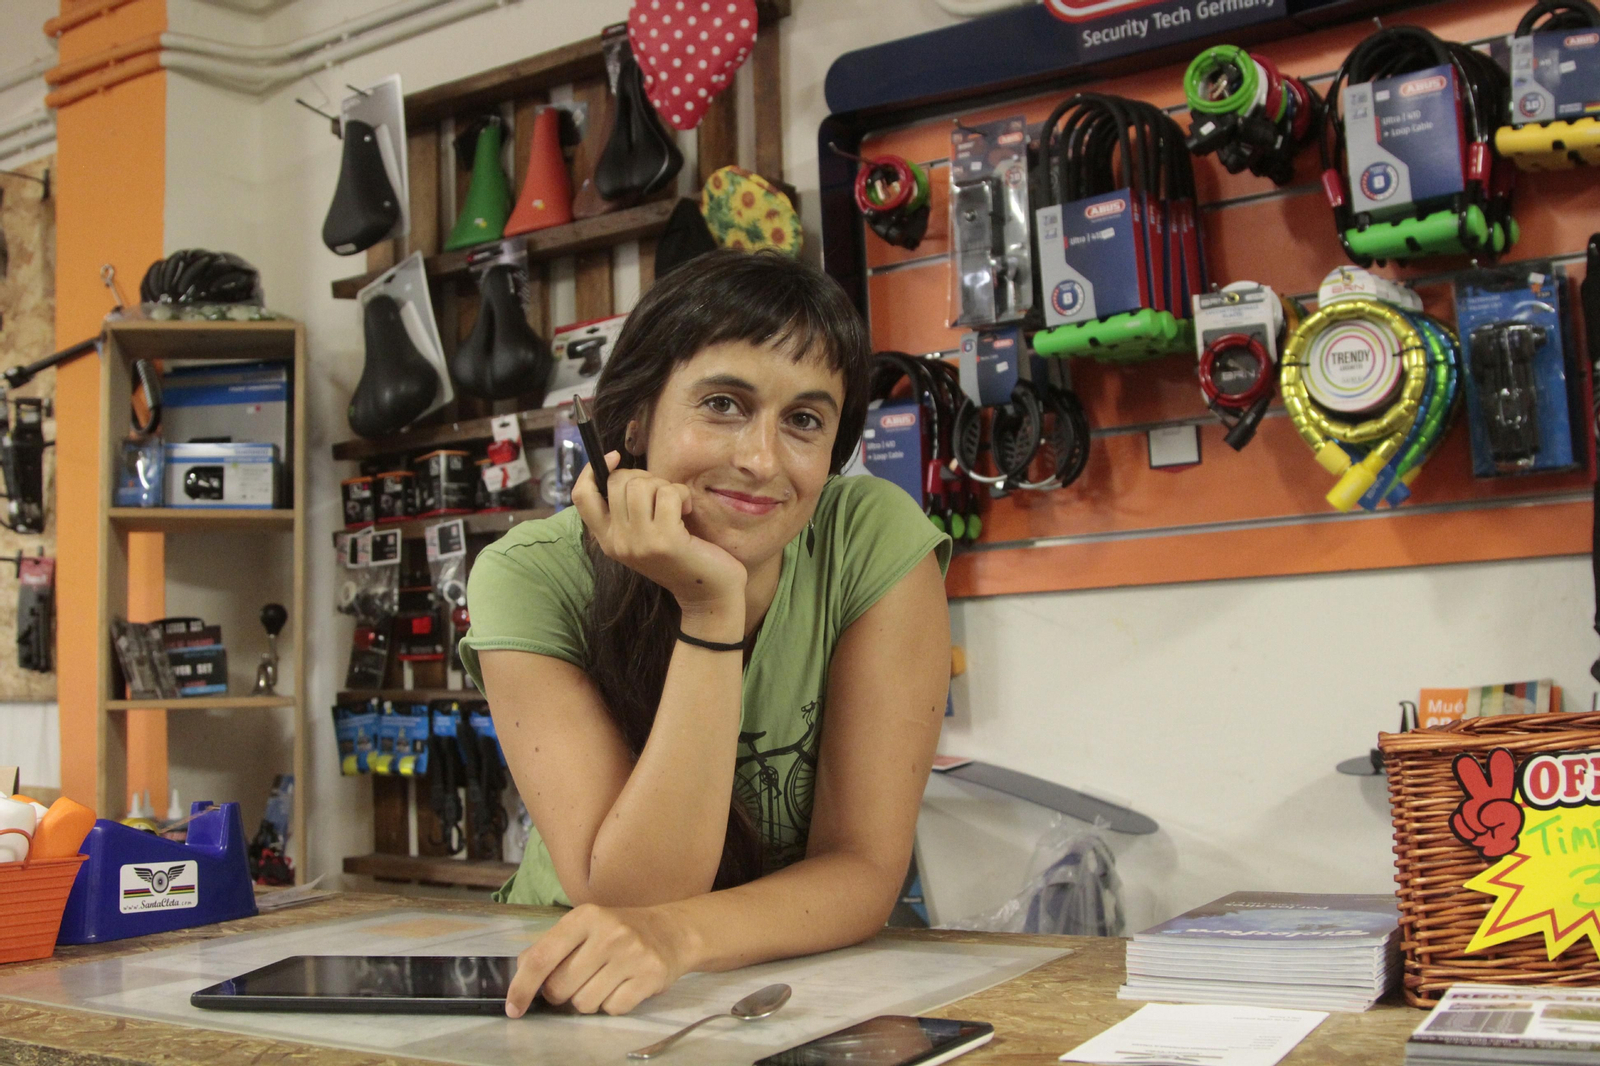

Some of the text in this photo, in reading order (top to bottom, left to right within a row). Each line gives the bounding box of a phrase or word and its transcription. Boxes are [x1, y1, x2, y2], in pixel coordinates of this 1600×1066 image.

[1082, 18, 1149, 47] Security
[1152, 6, 1191, 30] Tech
[1406, 80, 1441, 93] ABUS
[1382, 114, 1401, 125] Ultra
[1391, 127, 1411, 138] Loop
[1413, 121, 1434, 132] Cable
[1090, 202, 1122, 216] ABUS
[1070, 235, 1086, 246] Ultra
[1332, 284, 1365, 294] BRN
[1331, 349, 1371, 365] TRENDY
[885, 414, 912, 426] ABUS
[867, 441, 882, 450] Ultra
[888, 450, 905, 460] Cable
[196, 663, 213, 675] SET
